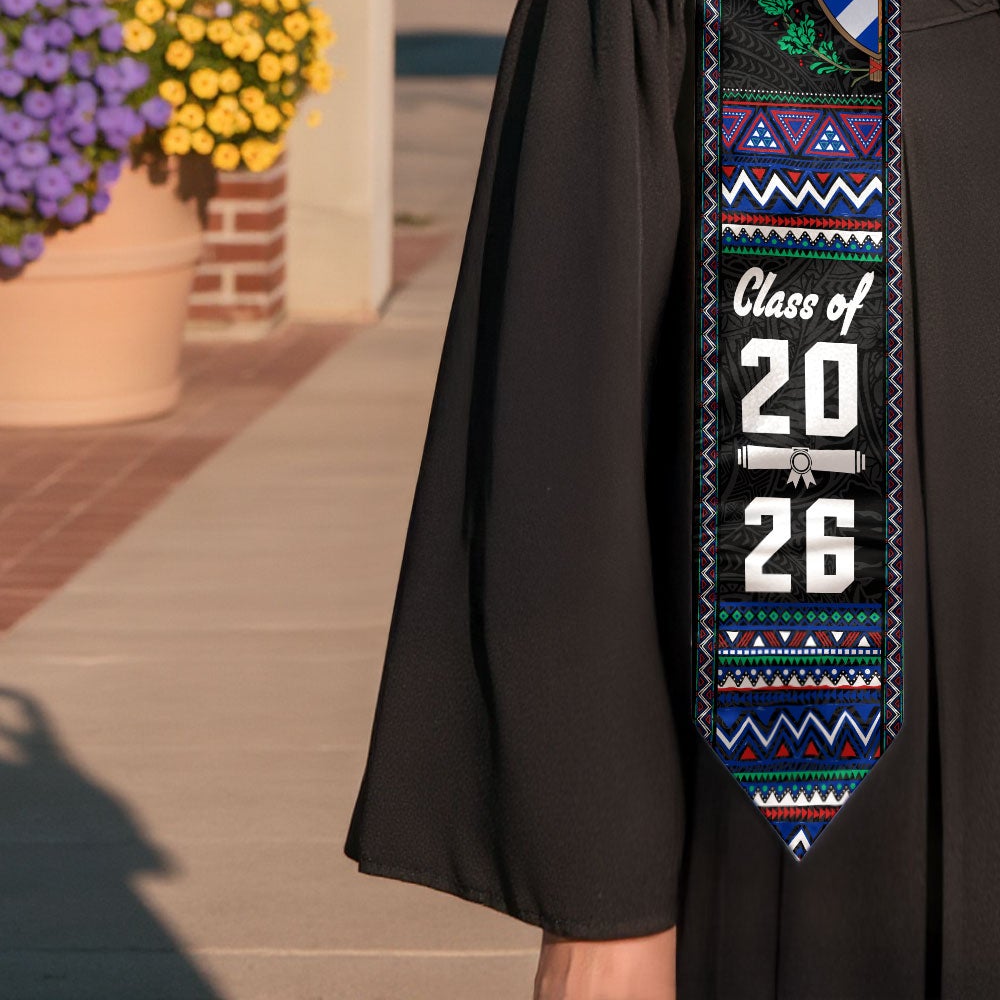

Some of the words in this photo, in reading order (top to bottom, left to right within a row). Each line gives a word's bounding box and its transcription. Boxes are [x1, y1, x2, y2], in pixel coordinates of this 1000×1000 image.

[733, 266, 819, 320] Class
[826, 271, 875, 336] of
[740, 337, 858, 438] 20
[744, 496, 855, 594] 26
